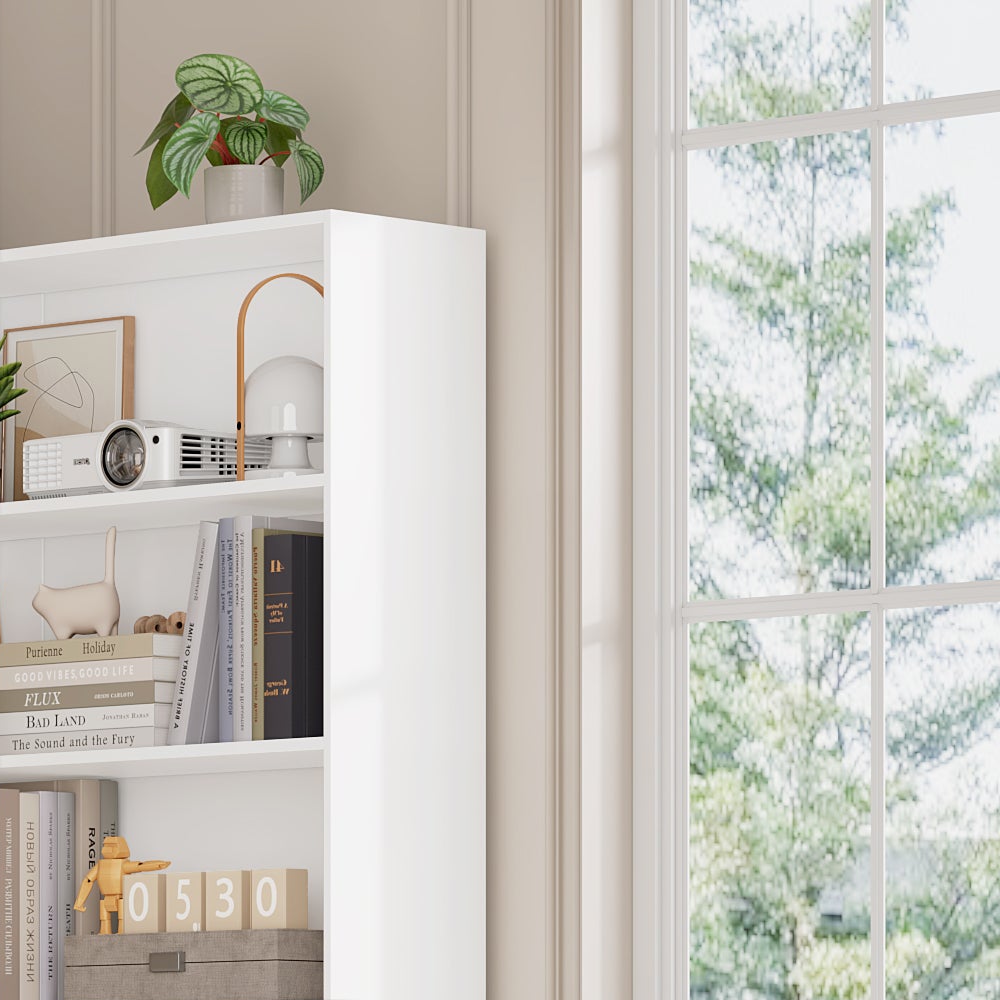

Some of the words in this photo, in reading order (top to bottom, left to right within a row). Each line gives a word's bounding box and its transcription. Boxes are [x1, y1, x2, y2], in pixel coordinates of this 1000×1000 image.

[26, 646, 63, 658] Purienne
[83, 641, 116, 656] Holiday
[14, 671, 43, 683] GOOD
[79, 666, 109, 679] GOOD
[112, 665, 134, 676] LIFE
[24, 692, 61, 706] FLUX
[12, 739, 30, 750] The
[34, 737, 65, 750] Sound
[70, 735, 88, 746] and
[92, 734, 108, 745] the
[112, 734, 135, 747] Fury
[26, 822, 36, 873] НОВЫЙ
[26, 880, 35, 924] ОБРАЗ
[129, 882, 148, 922] 0
[176, 879, 191, 920] 5
[216, 878, 234, 918] 3
[256, 876, 277, 917] 0
[26, 930, 35, 982] ЖИЗНИ
